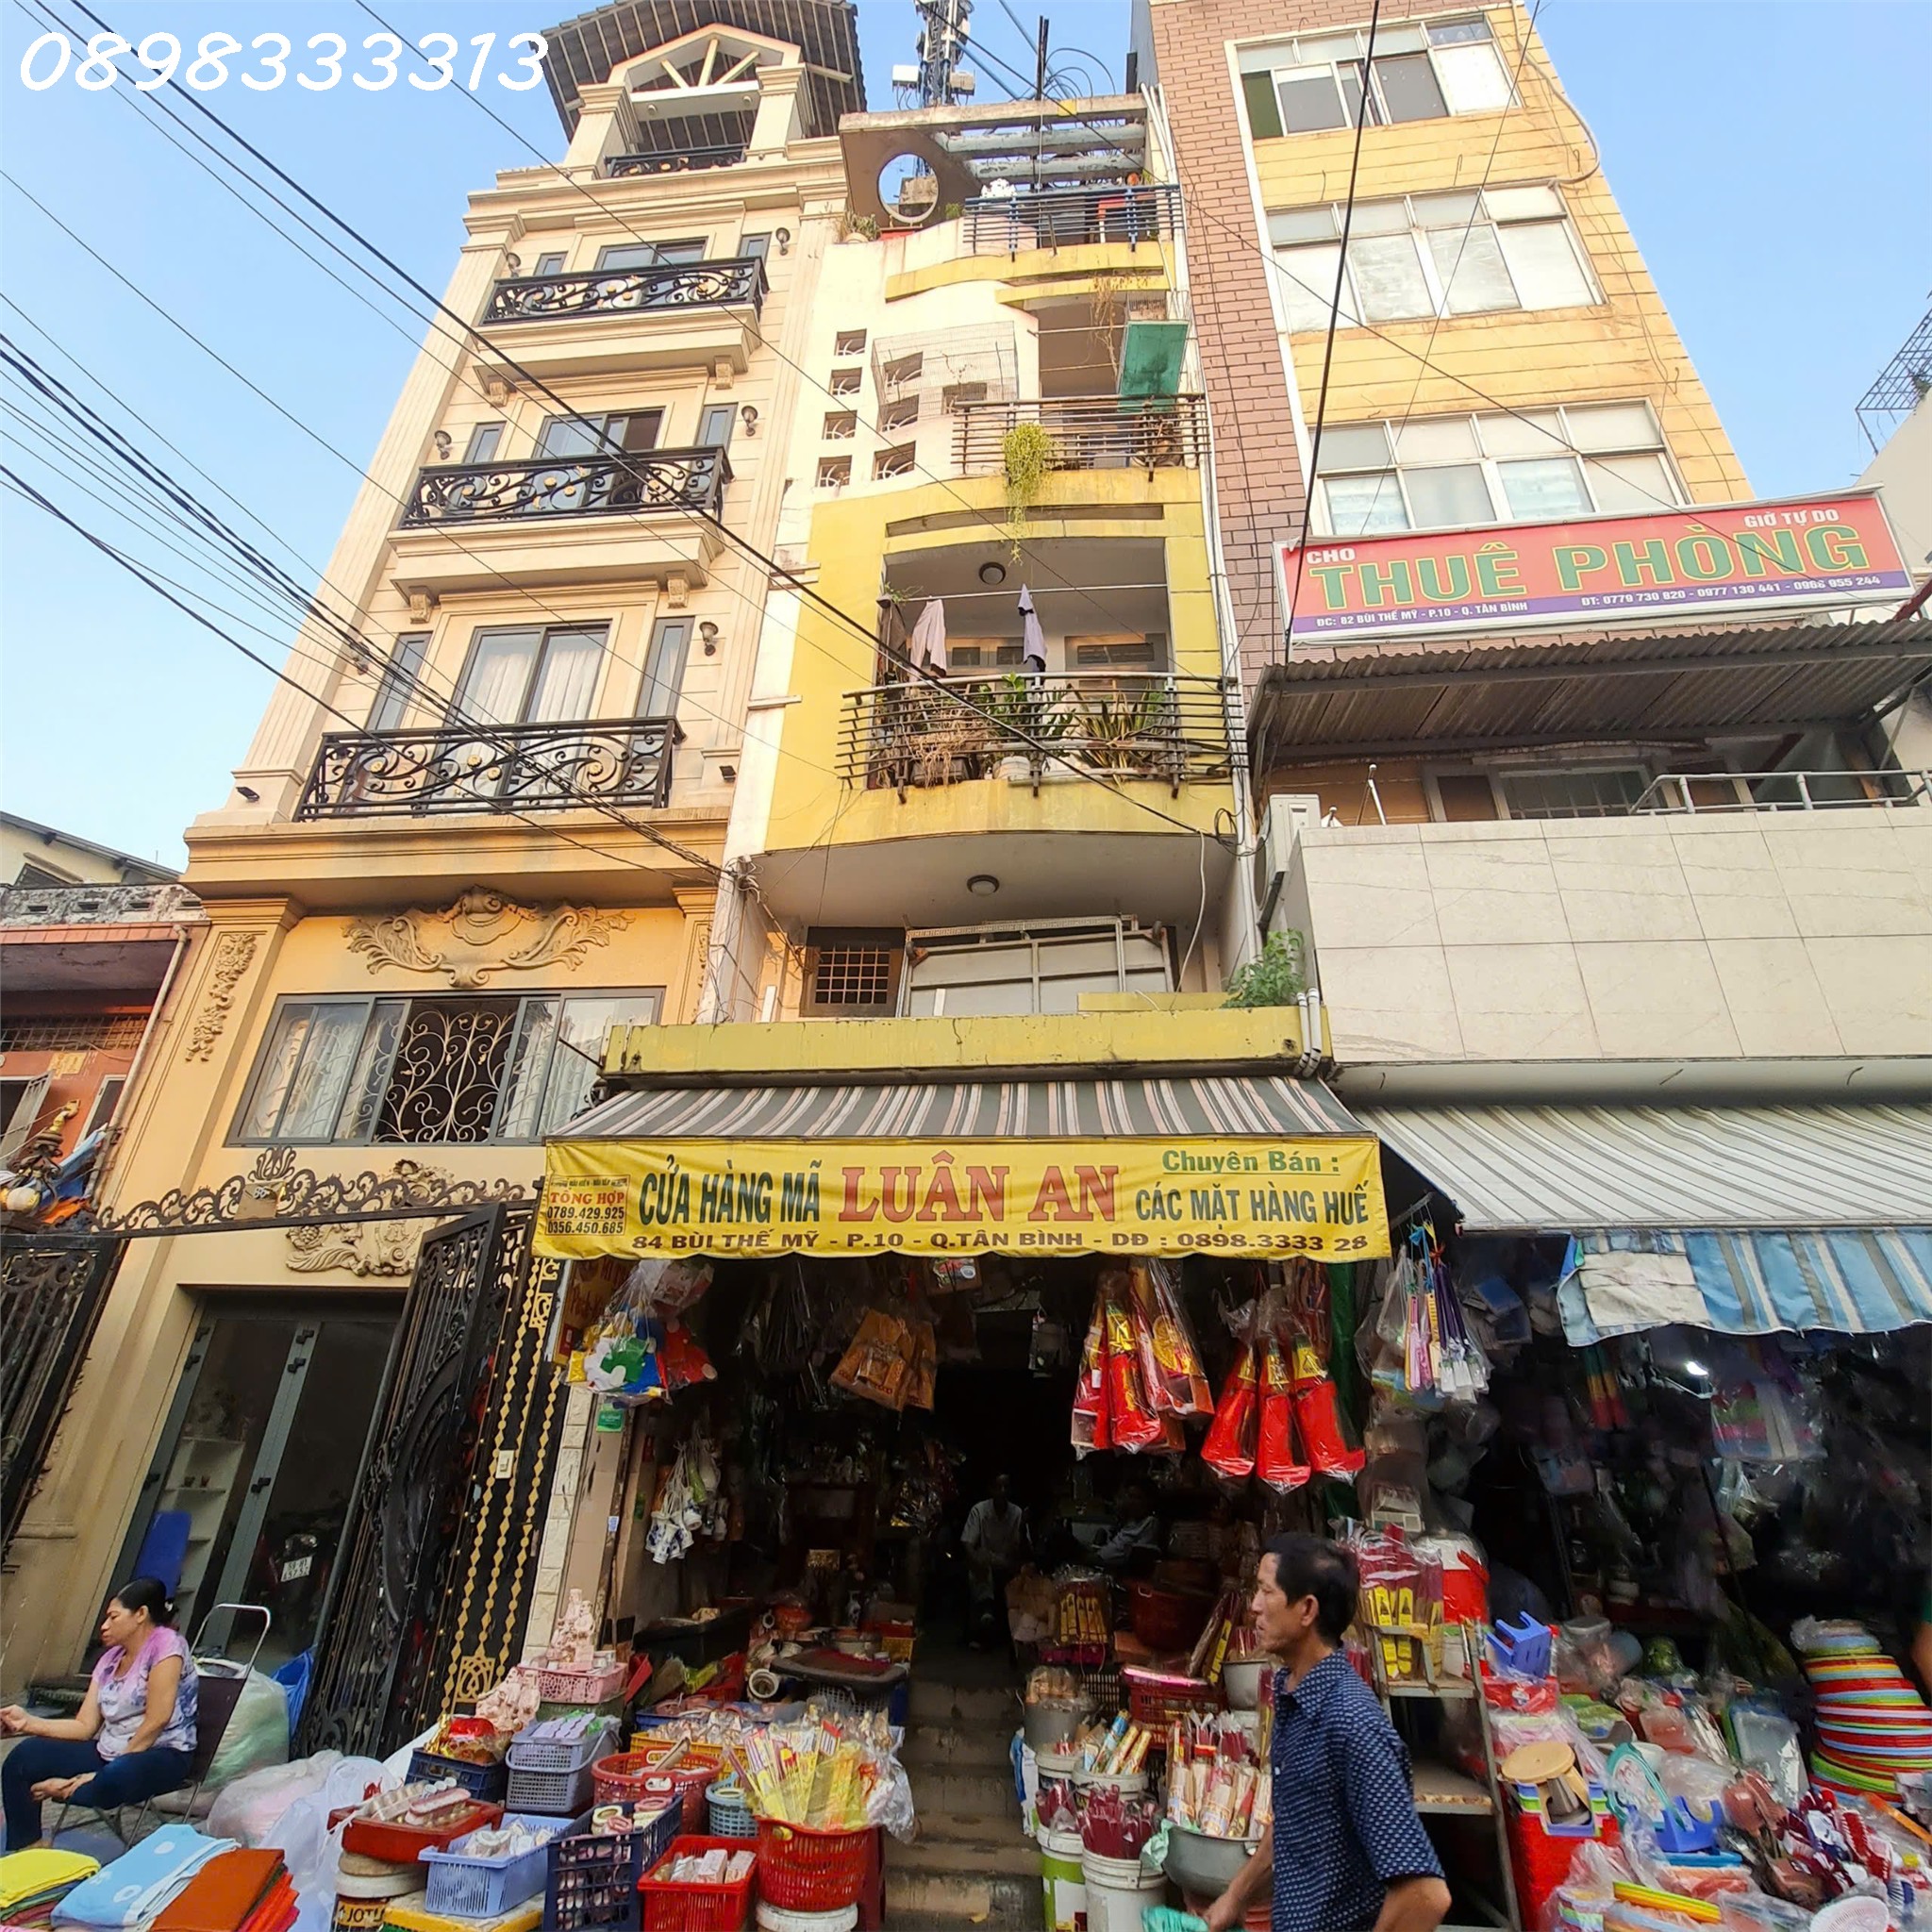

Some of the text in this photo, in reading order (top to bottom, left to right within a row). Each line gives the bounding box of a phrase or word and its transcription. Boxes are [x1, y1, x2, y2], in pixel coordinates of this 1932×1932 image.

[1743, 508, 1840, 528] GIỜ TỰ DO
[1307, 548, 1356, 564] CHO
[1309, 525, 1871, 610] THUÊ PHÒNG
[1636, 592, 1659, 602] 730
[1697, 587, 1727, 597] 0977
[1732, 585, 1755, 594] 130
[1758, 583, 1781, 592] 441
[1856, 576, 1881, 586] 244
[1341, 615, 1355, 625] 82
[1357, 612, 1375, 624] BÙI
[1377, 610, 1398, 622] THẾ
[1401, 608, 1418, 620] MỸ
[1428, 608, 1451, 618] P.10
[1461, 606, 1474, 616] Q.
[1474, 604, 1498, 614] TÂN
[1500, 602, 1528, 612] BÌNH
[1162, 1150, 1257, 1174] Chuyên
[1268, 1150, 1321, 1172] Bán
[596, 1190, 625, 1206] HỢP
[639, 1154, 822, 1225] CỬA HÀNG MÃ
[839, 1150, 1119, 1223] LUÂN AN
[547, 1207, 625, 1219] 0789.429.925
[1136, 1180, 1369, 1229] CÁC MẶT HÀNG HUẾ
[547, 1221, 624, 1234] 0356.450.685
[632, 1236, 662, 1249] 84
[672, 1231, 712, 1248] BÙI
[722, 1228, 774, 1247] THẾ
[781, 1230, 819, 1247] MỸ
[847, 1233, 904, 1247] P.10
[930, 1230, 1008, 1248] Q.TÂN
[1019, 1230, 1082, 1245] BÌNH
[1177, 1233, 1324, 1250] 0898.3333
[1334, 1236, 1368, 1252] 28
[347, 1907, 386, 1923] JOTU
